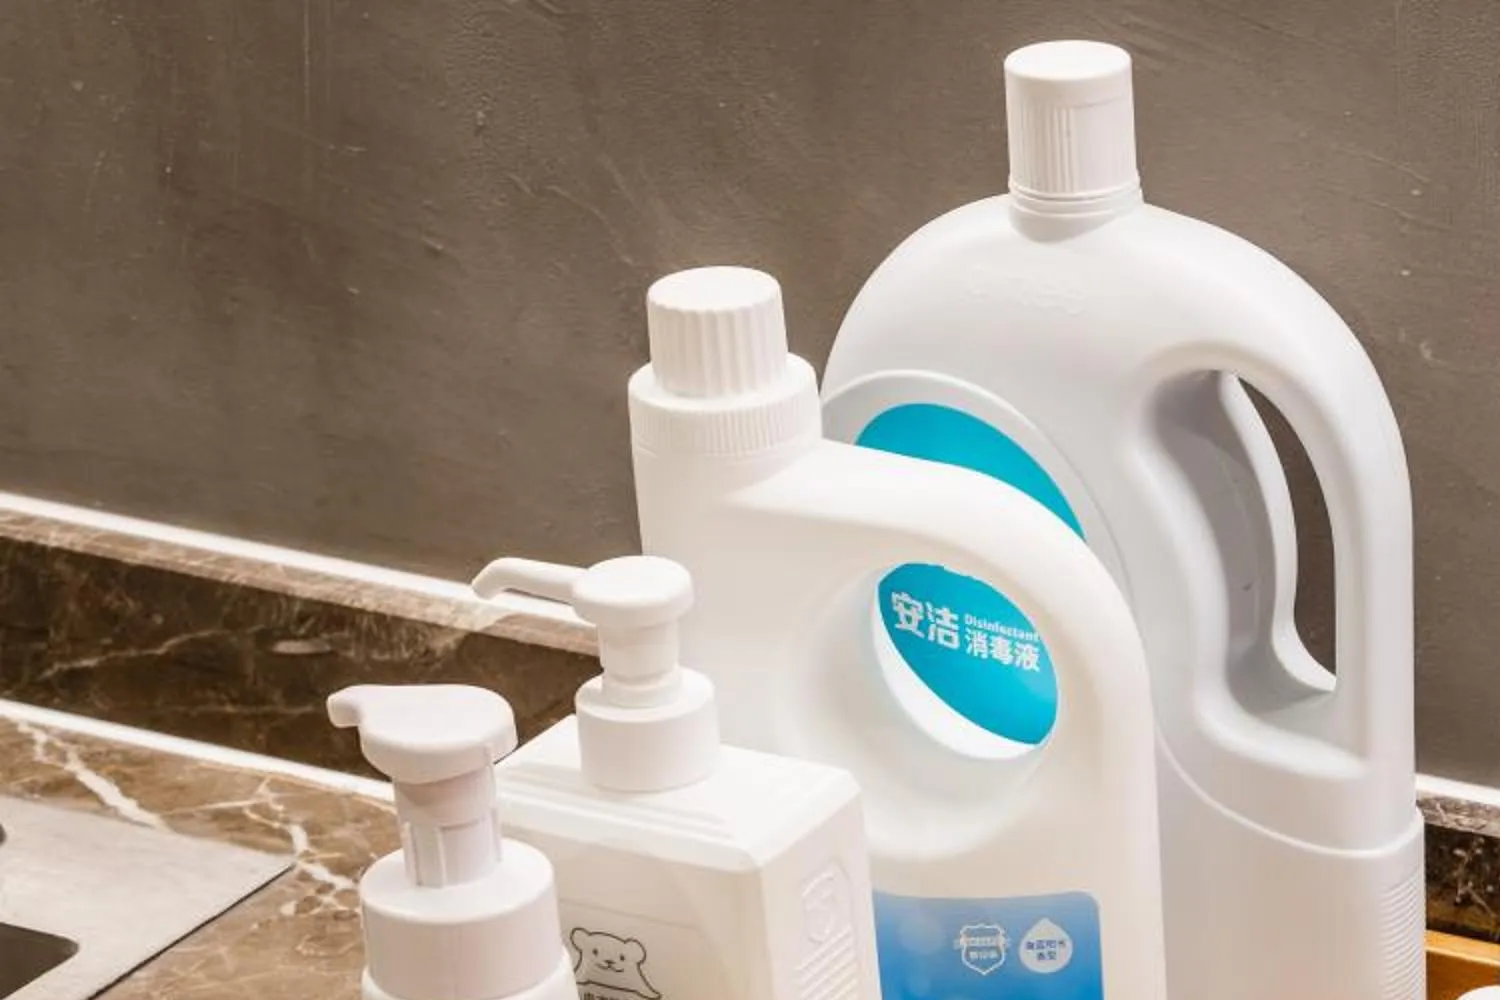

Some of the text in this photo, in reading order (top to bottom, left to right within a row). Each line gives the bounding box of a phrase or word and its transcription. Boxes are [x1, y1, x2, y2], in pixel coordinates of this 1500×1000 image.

[891, 591, 1041, 673] 安洁 消毒液
[964, 613, 1040, 641] Disinfectant
